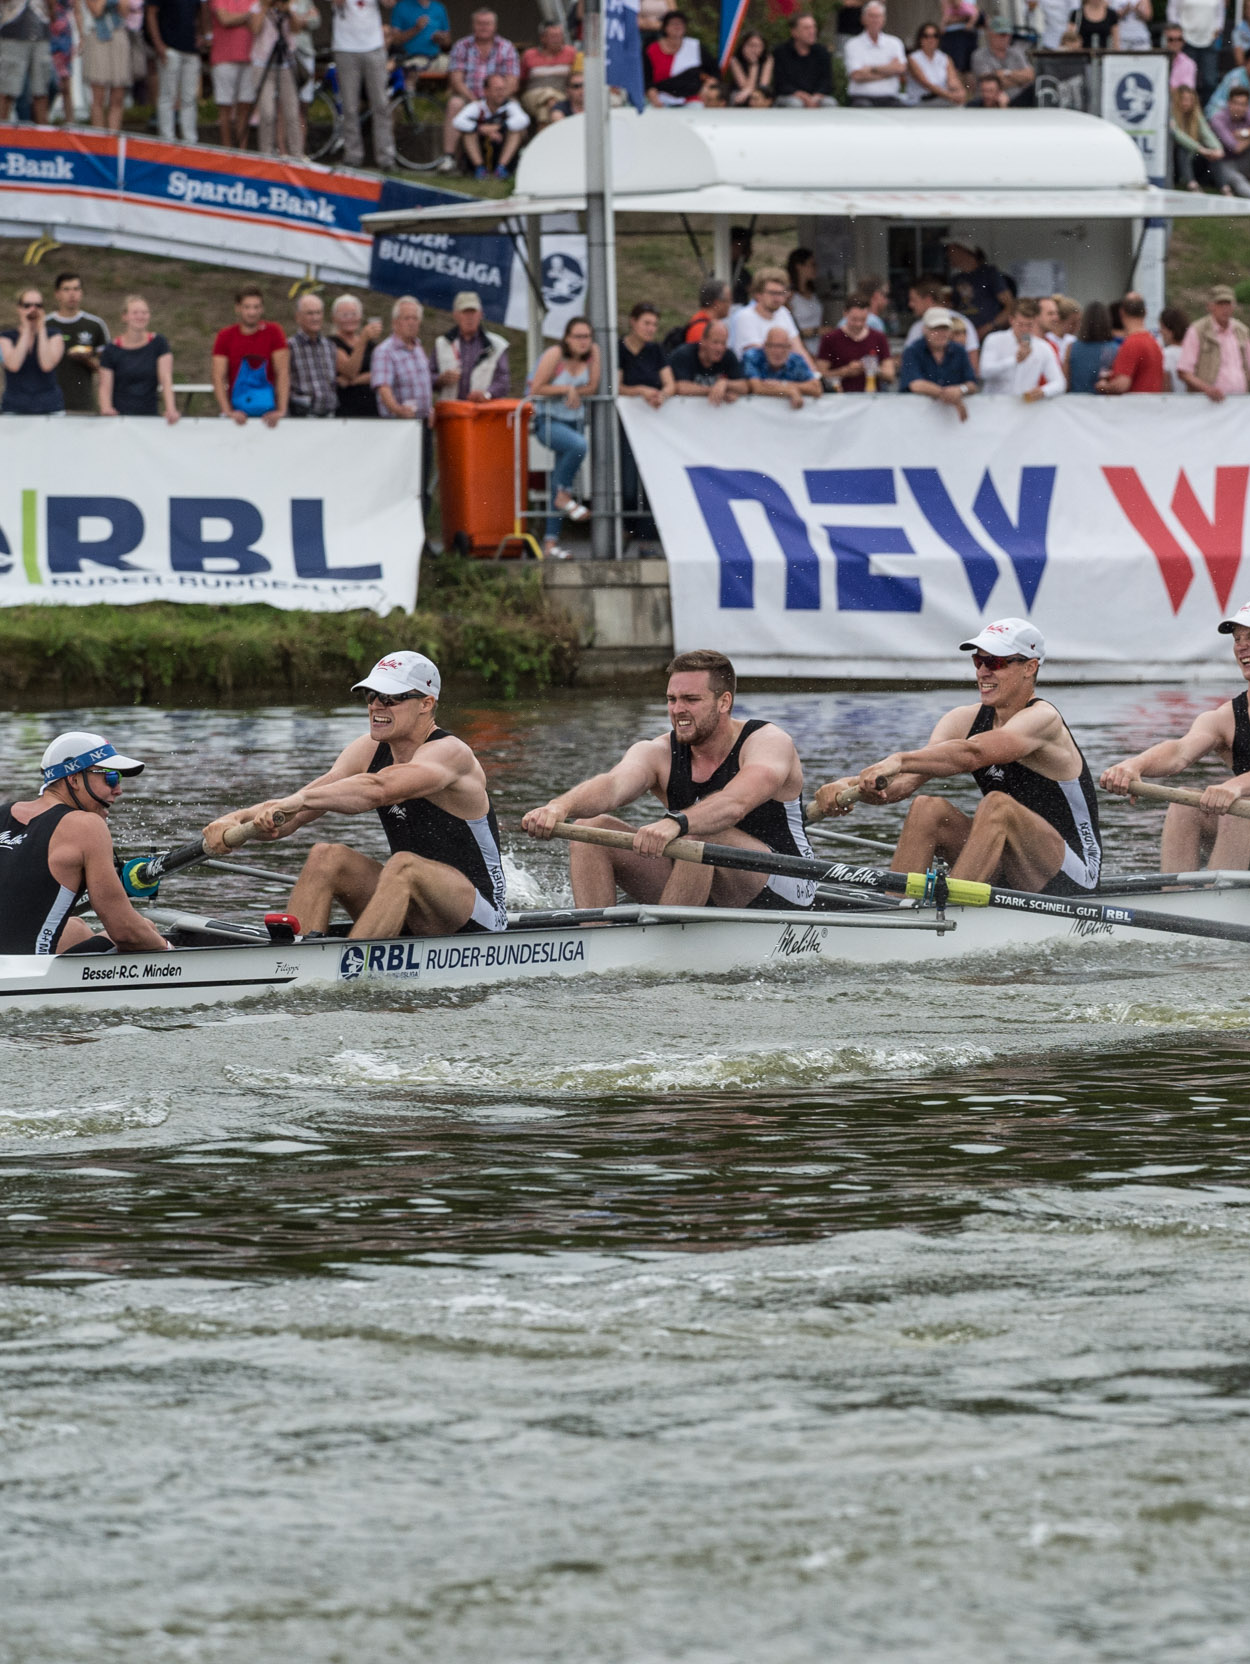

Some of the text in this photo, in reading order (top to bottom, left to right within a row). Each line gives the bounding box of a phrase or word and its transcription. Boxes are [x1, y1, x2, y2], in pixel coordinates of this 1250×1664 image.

[167, 169, 337, 223] Sparda-Bank
[378, 239, 503, 288] BUNDESLIGA
[46, 496, 384, 581] RBL
[685, 465, 1057, 614] NEW
[64, 760, 81, 774] NK
[90, 748, 108, 761] NK
[994, 894, 1132, 921] STARK. SCHNELL. GUT. RBL
[81, 963, 182, 981] Bessel-R.C. Minden
[368, 940, 584, 971] RBL RUDER-BUNDESLIGA
